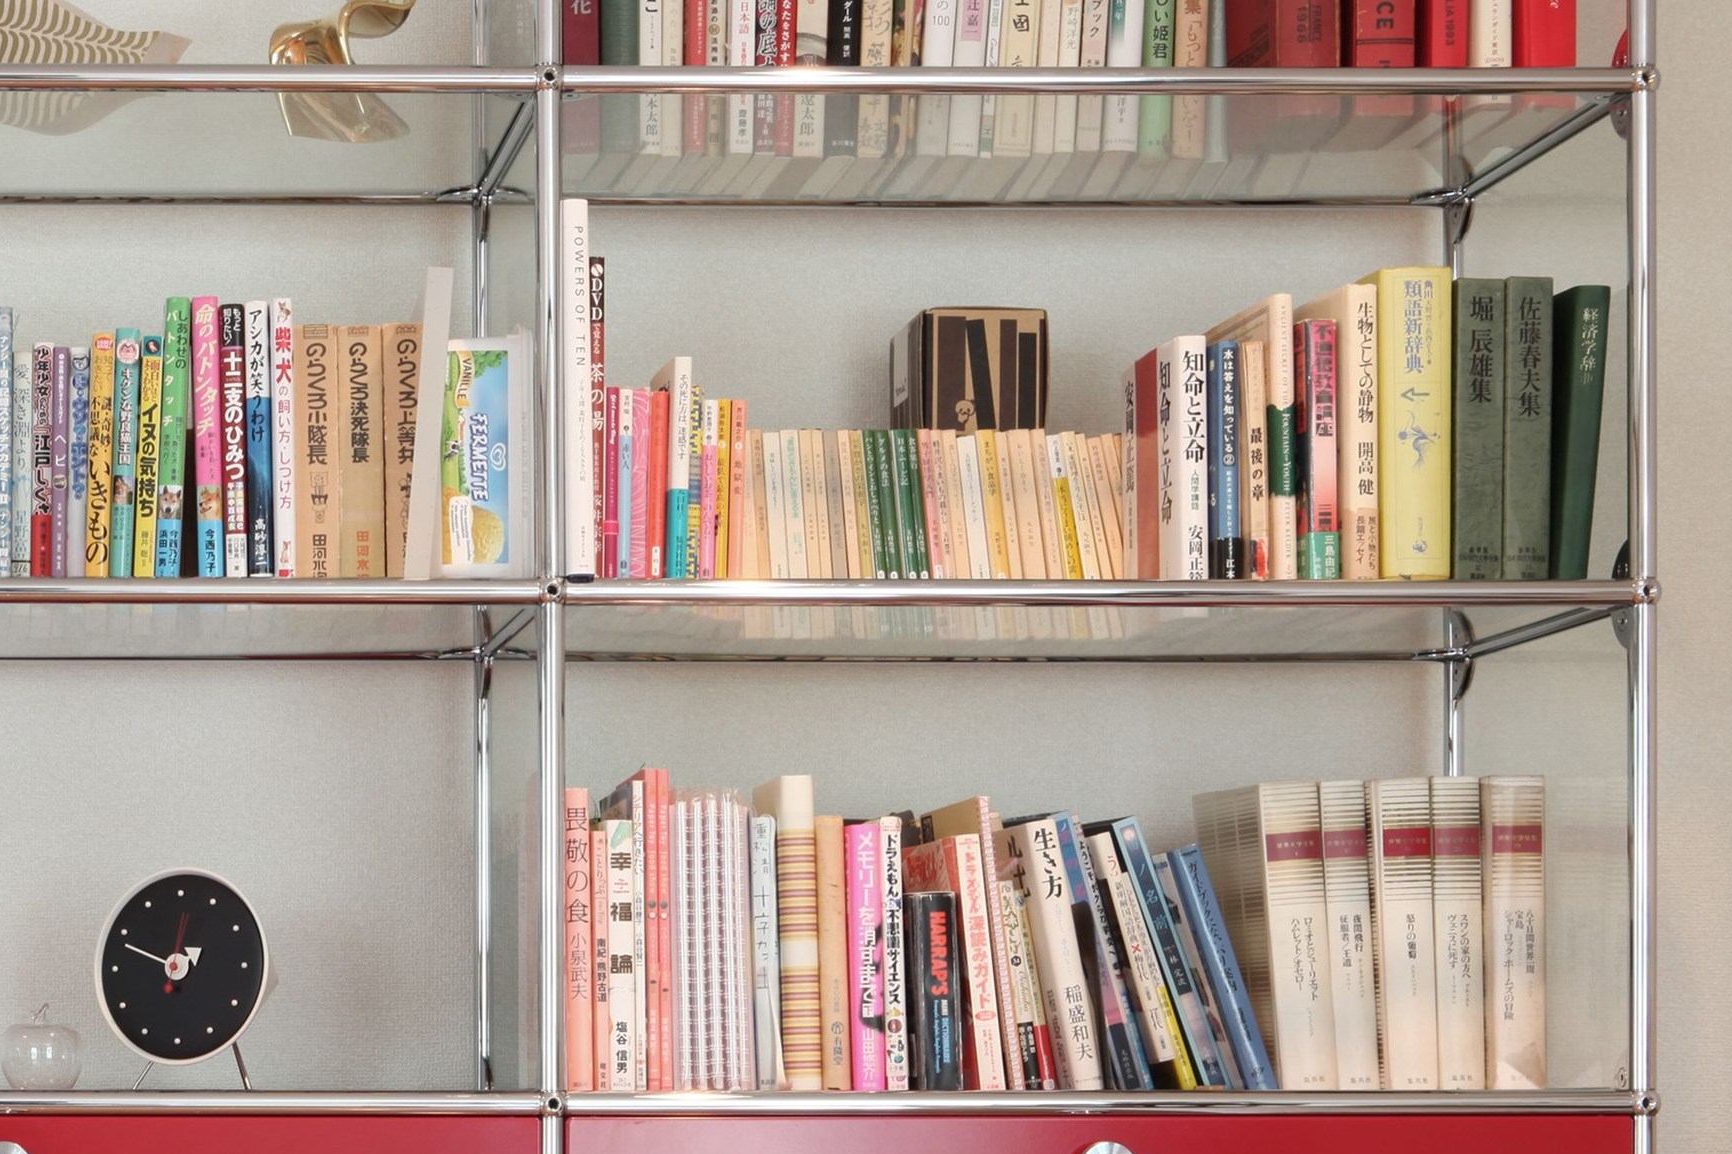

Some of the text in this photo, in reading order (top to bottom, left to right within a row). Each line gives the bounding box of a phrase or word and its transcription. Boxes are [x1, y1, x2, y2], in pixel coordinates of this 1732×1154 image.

[932, 16, 949, 26] 100
[233, 307, 242, 332] もっと
[574, 226, 586, 366] POWERS OF TEN
[591, 278, 603, 321] DVD
[1404, 280, 1423, 374] 類語新辞典
[163, 310, 178, 426] バトンタッチ
[176, 310, 188, 370] しあわせの
[196, 304, 216, 437] 命のバトンタッチ
[249, 310, 265, 443] アシカが笑うわけ
[457, 358, 472, 399] VANILLE
[1357, 302, 1374, 424] 生物としての静物
[1518, 296, 1542, 417] 佐藤春夫集
[120, 368, 132, 466] キケンな野良猫王国
[306, 342, 328, 466] のらくろ小隊長
[349, 342, 370, 464] のらくろ決死隊長
[590, 362, 604, 432] 茶の湯
[1182, 350, 1206, 464] 知命と立命
[139, 402, 158, 517] イヌの気持ち
[469, 413, 489, 502] FERMETTE
[1250, 428, 1264, 502] 最後の章
[204, 530, 216, 573] 今西乃子
[566, 806, 589, 924] 畏敬の食
[1033, 828, 1062, 899] 生き方
[610, 851, 633, 976] 幸福論
[930, 911, 948, 996] HARRAP'S
[1353, 914, 1363, 952] 夜間飛行
[1406, 914, 1417, 960] 怒りの葡萄
[1514, 910, 1524, 930] 宝島
[570, 932, 589, 1000] 小泉武夫
[1064, 986, 1093, 1061] 稲盛和夫
